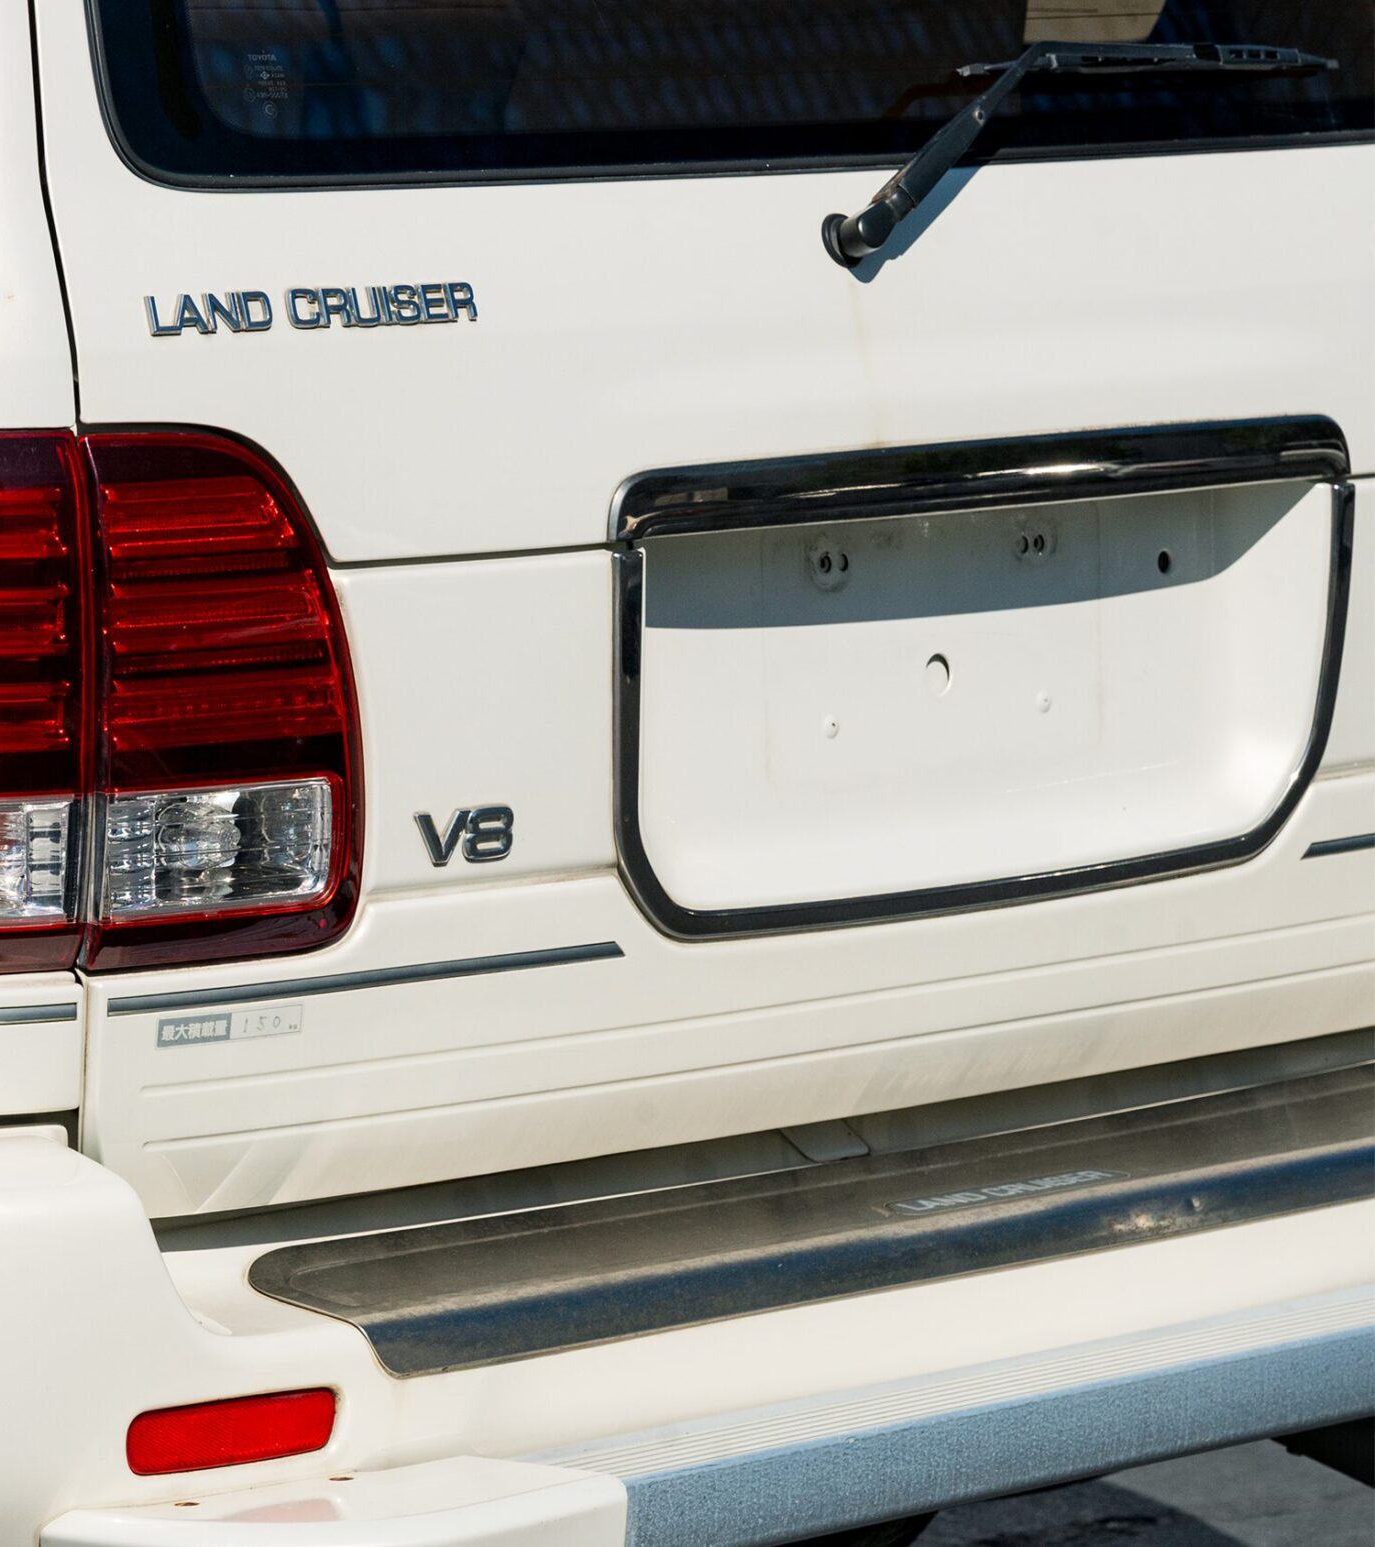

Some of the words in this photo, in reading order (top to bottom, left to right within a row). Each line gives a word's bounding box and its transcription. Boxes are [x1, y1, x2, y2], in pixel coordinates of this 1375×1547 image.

[143, 290, 273, 336] LAND
[284, 282, 478, 329] CRUISER
[413, 804, 514, 867] V8
[161, 1020, 228, 1042] 最大積載量
[896, 1191, 987, 1211] LAND
[981, 1170, 1113, 1197] CRUISER
